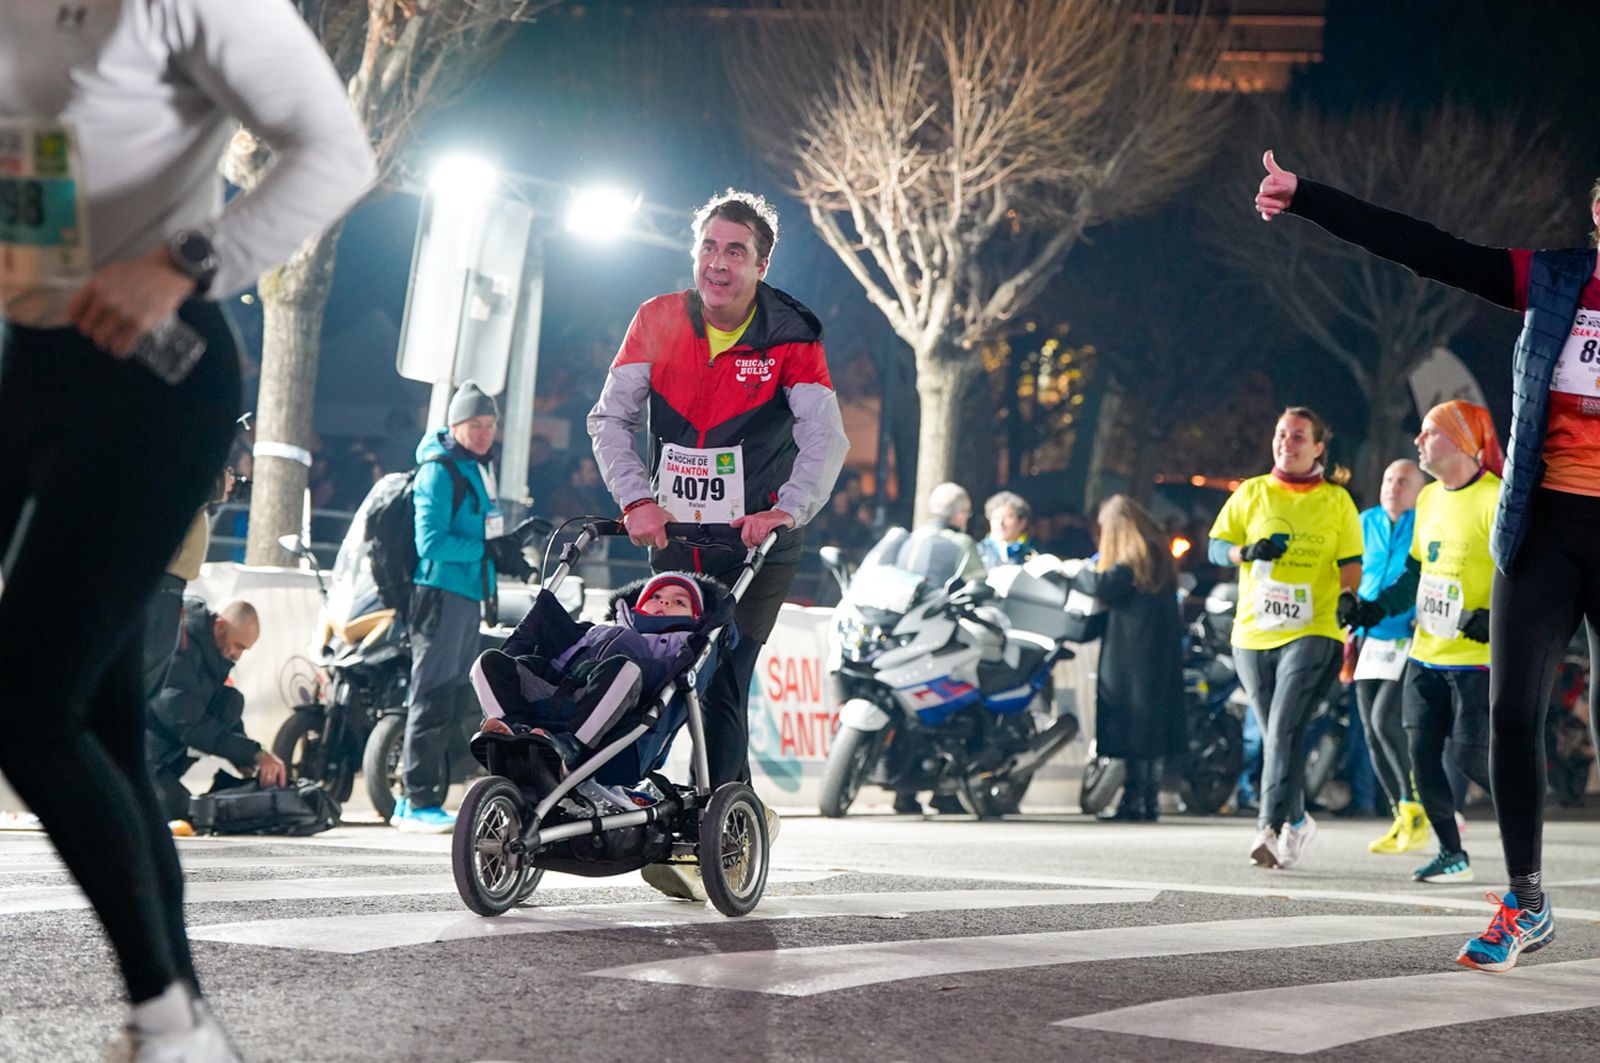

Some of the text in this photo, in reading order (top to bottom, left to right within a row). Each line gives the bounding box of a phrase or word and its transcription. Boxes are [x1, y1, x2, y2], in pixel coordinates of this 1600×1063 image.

[1572, 328, 1590, 337] SAN
[735, 358, 776, 367] CHICAGO
[740, 367, 769, 375] BULLS
[674, 455, 708, 466] NOCHE DE
[666, 462, 680, 473] SAN
[681, 465, 709, 476] ANTÓN
[673, 476, 725, 502] 4079
[1264, 600, 1301, 619] 2042
[1423, 596, 1450, 618] 2041
[768, 656, 820, 703] SAN
